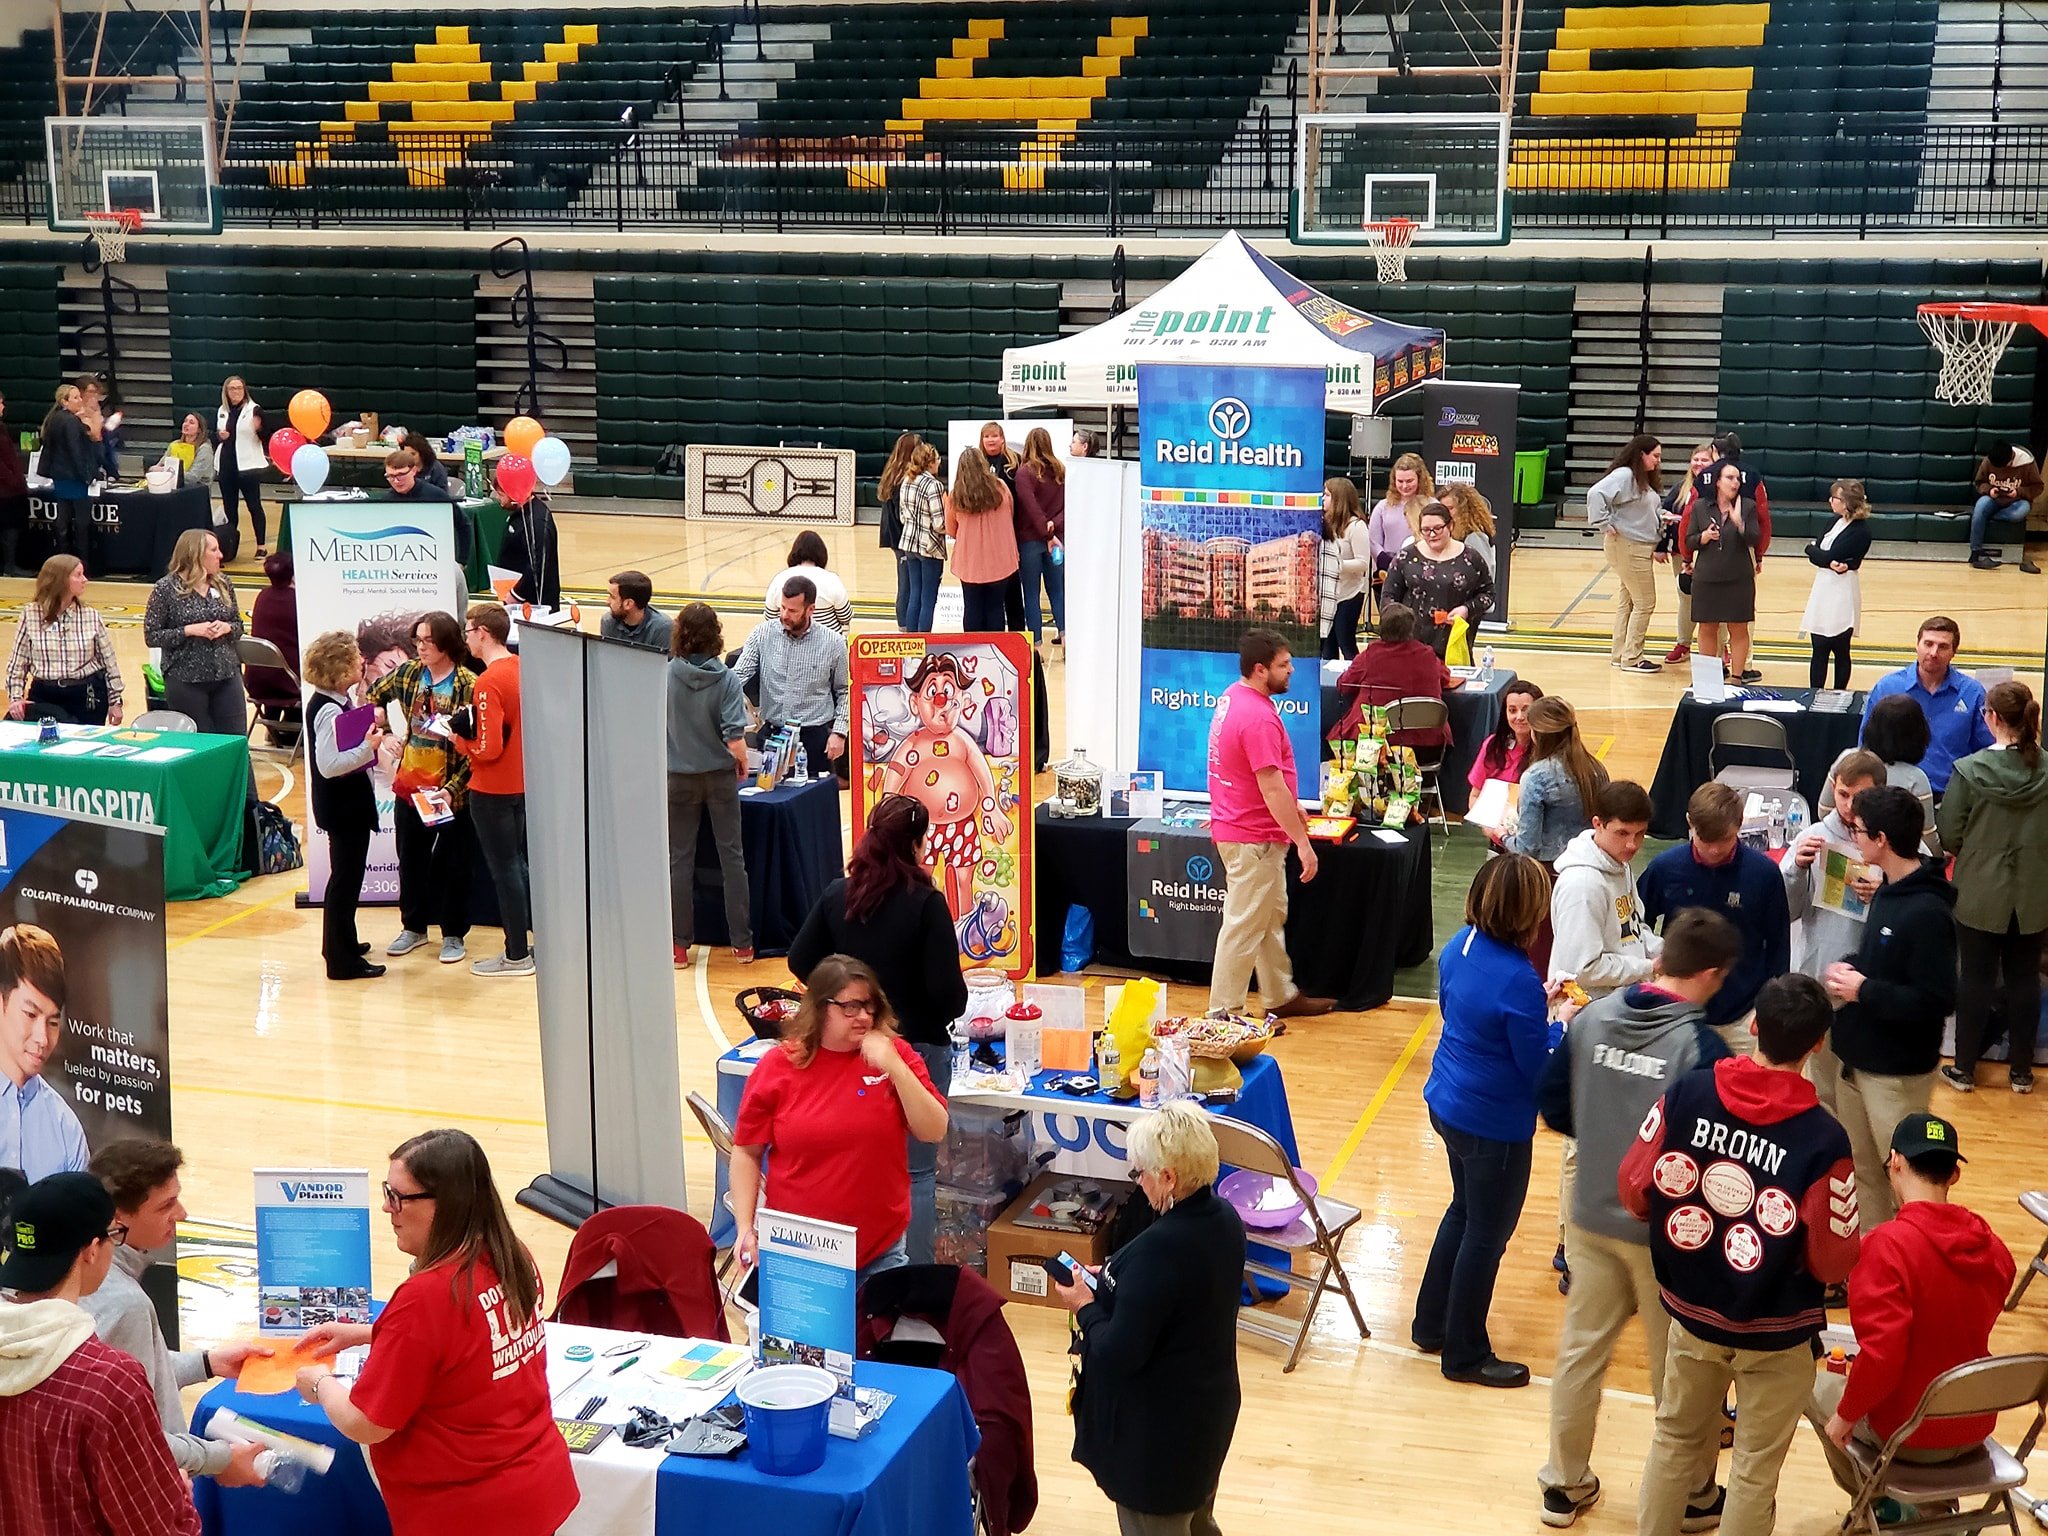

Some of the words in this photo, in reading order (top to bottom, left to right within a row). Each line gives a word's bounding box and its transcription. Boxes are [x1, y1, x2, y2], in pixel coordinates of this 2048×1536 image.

[1128, 311, 1159, 333] the
[1153, 304, 1276, 336] point
[1021, 361, 1066, 383] point
[1326, 363, 1361, 384] oint
[1455, 435, 1482, 447] KICKS
[1484, 435, 1497, 447] 96
[1156, 439, 1214, 464] Reid
[1219, 441, 1302, 468] Health
[1444, 464, 1475, 479] point
[27, 497, 120, 523] PUUE
[309, 537, 438, 562] MERIDIAN
[342, 569, 390, 580] HEALTH
[391, 568, 438, 581] Services
[859, 640, 924, 656] OPERATION
[1151, 688, 1200, 710] Right
[1275, 699, 1309, 715] you
[1151, 880, 1190, 899] Reid
[1194, 884, 1227, 902] Hea
[116, 904, 156, 923] COMPANY
[1169, 900, 1189, 912] Right
[1189, 903, 1217, 912] beside
[68, 1018, 104, 1040] Work
[107, 1026, 135, 1047] that
[91, 1044, 161, 1079] matters,
[64, 1059, 96, 1078] fueled
[98, 1067, 112, 1084] by
[113, 1074, 154, 1093] passion
[75, 1081, 101, 1105] for
[105, 1092, 143, 1116] pets
[1690, 1117, 1788, 1176] BROWN
[280, 1181, 344, 1203] VANDOR
[299, 1191, 344, 1200] Plastics
[491, 1338, 525, 1369] WHAT
